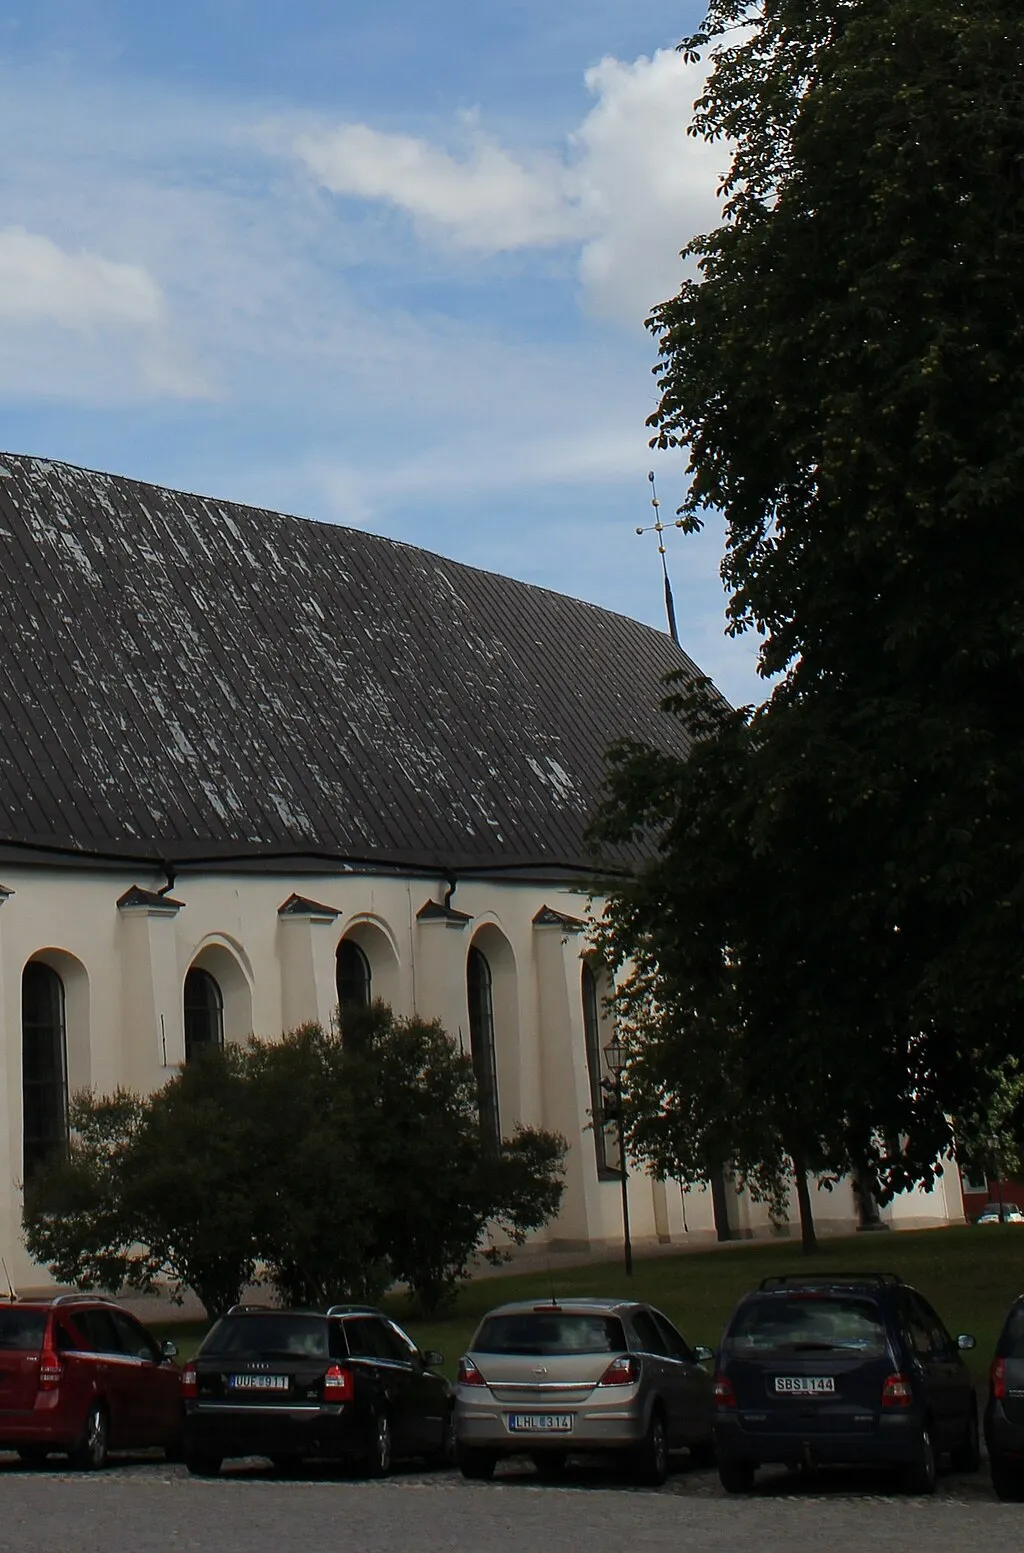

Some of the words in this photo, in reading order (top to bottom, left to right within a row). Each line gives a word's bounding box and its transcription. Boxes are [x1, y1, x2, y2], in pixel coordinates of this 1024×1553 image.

[265, 1376, 285, 1387] 911
[777, 1378, 801, 1390] SBS
[810, 1378, 833, 1390] 144
[516, 1416, 536, 1427] LHL
[547, 1416, 568, 1427] 314
